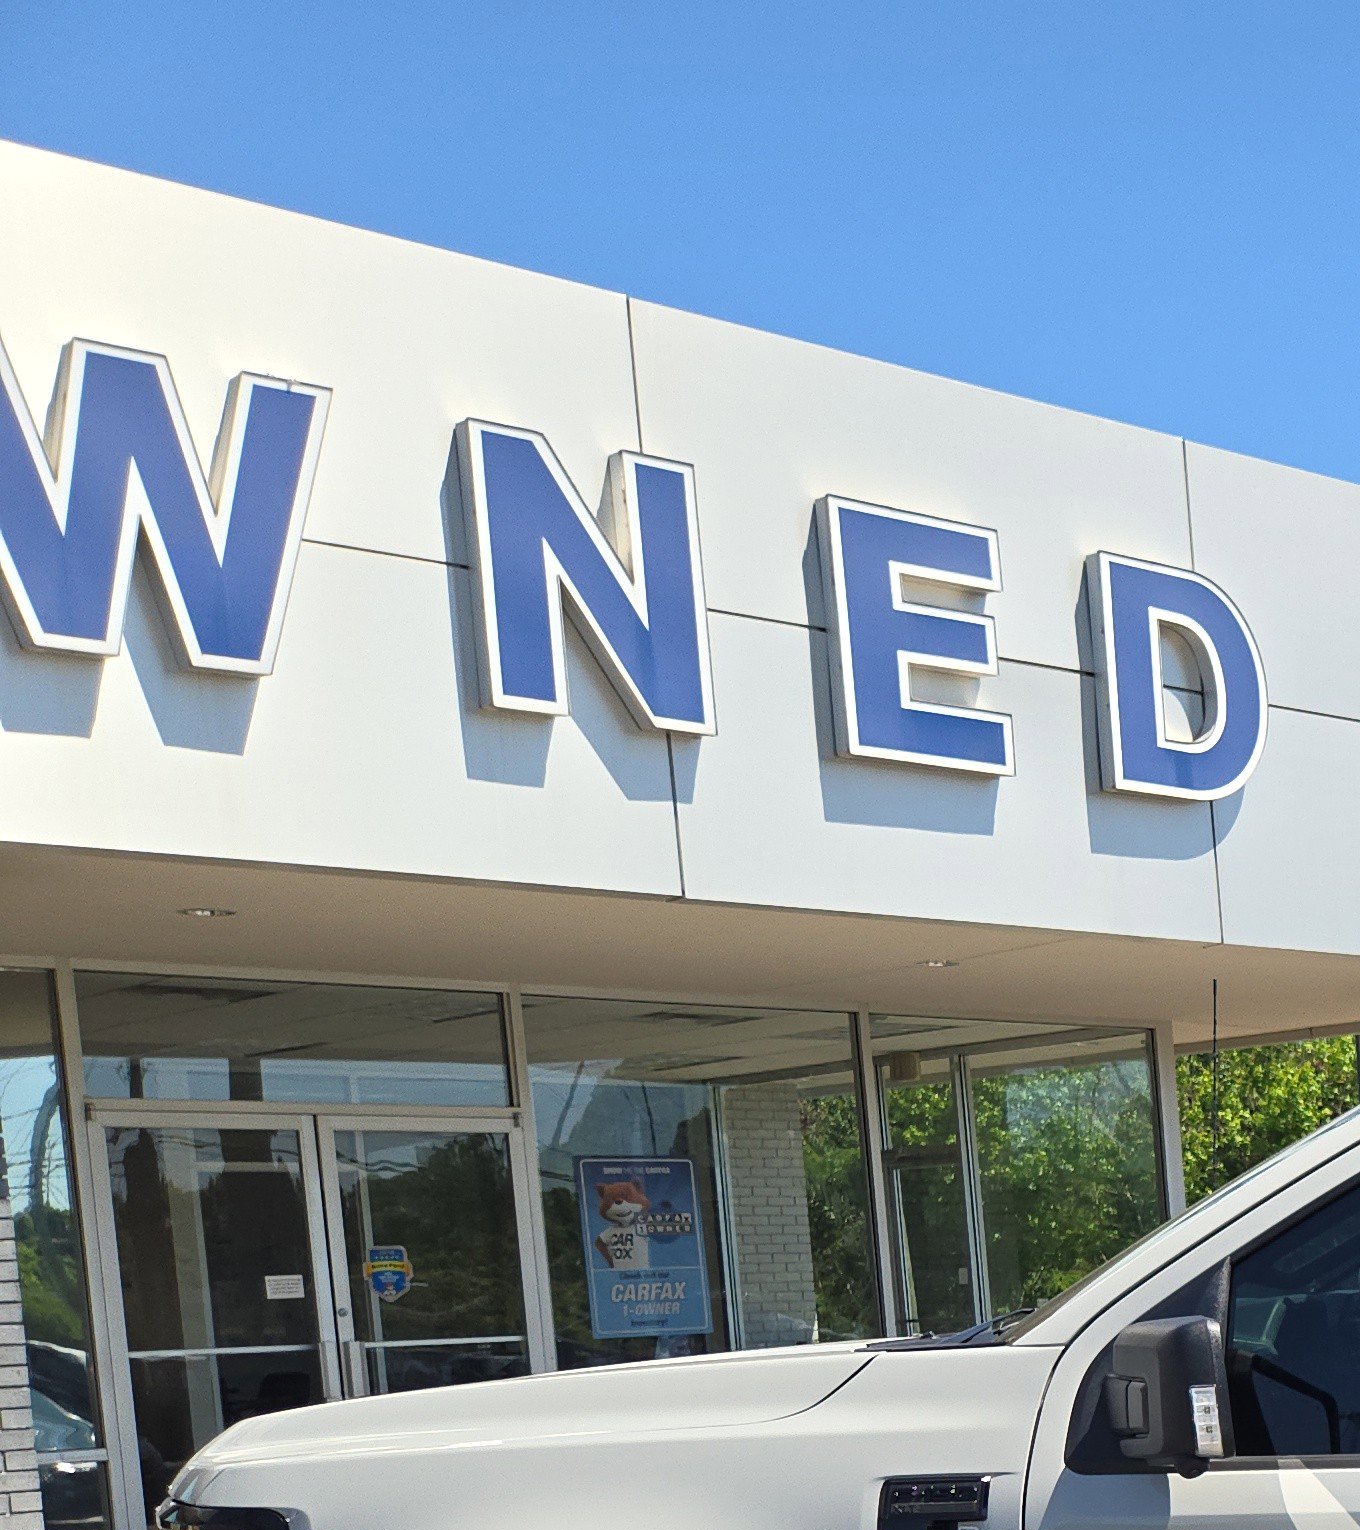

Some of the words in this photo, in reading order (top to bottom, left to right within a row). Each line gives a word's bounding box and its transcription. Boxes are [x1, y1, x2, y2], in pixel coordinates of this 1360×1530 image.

[611, 1233, 634, 1247] CAR
[611, 1281, 687, 1303] CARFAX
[623, 1302, 681, 1318] 1-OWNER
